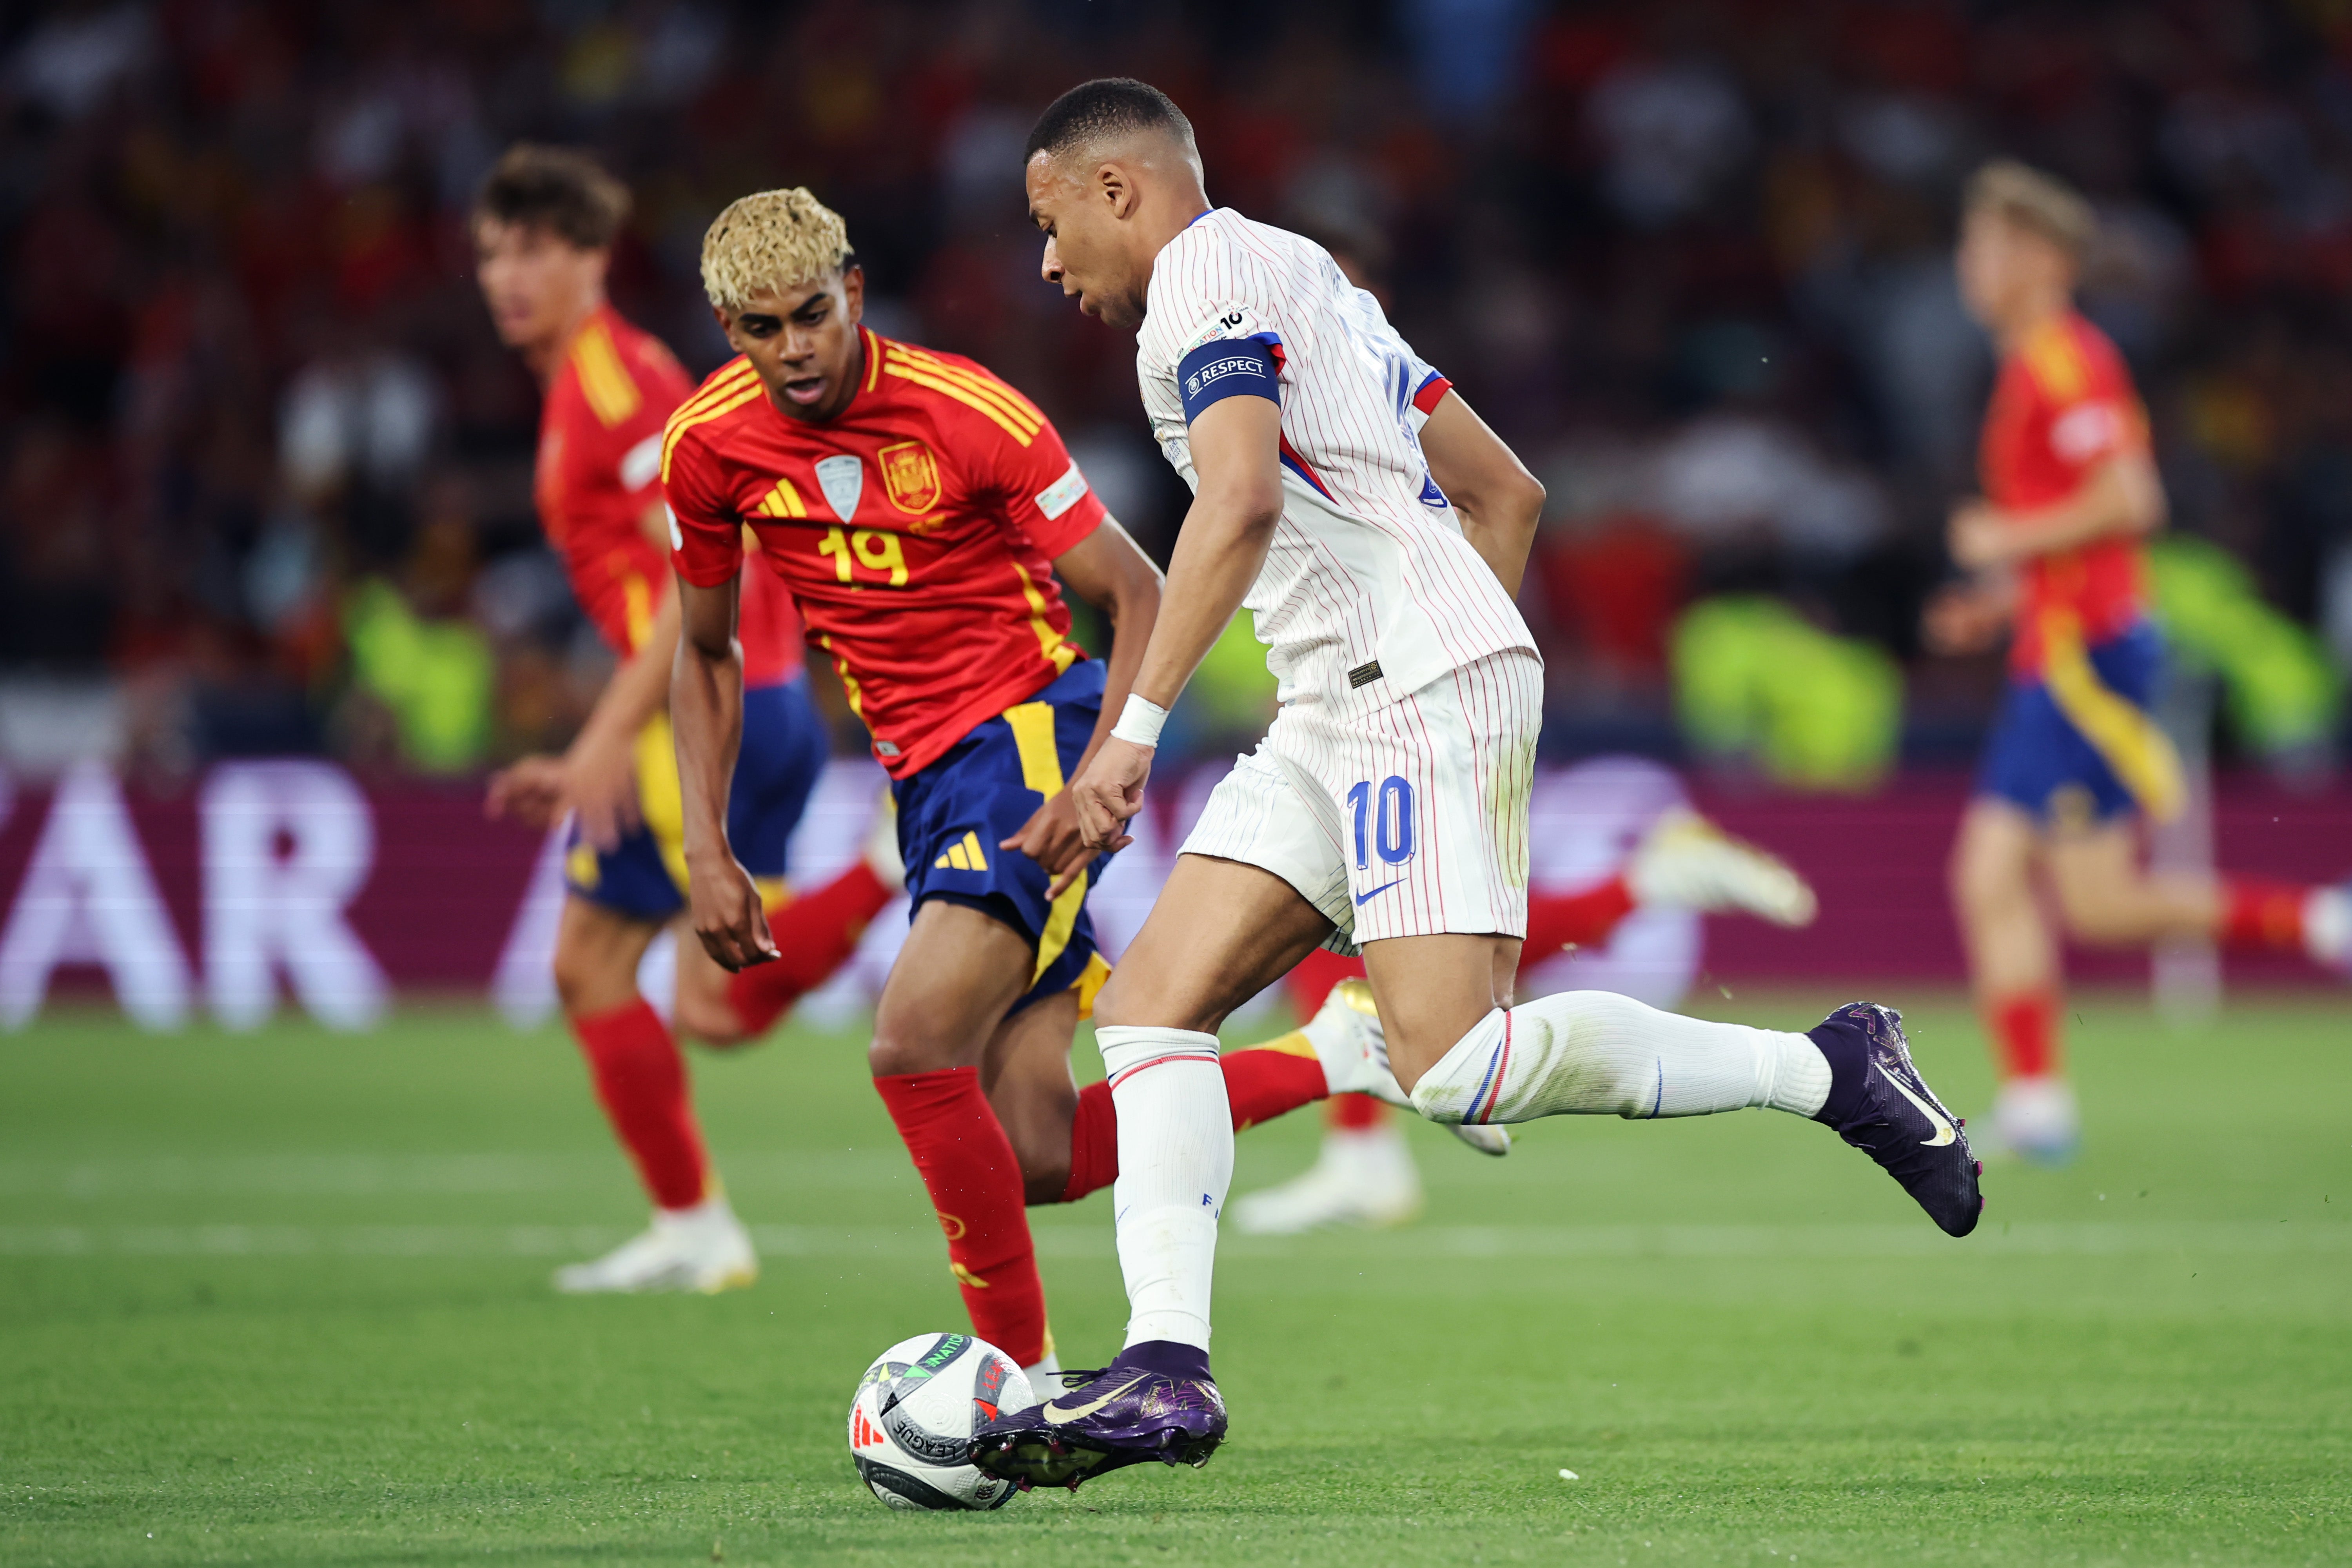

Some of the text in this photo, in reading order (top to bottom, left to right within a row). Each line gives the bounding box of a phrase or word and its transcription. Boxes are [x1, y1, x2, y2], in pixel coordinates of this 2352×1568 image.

[1220, 312, 1242, 330] 10
[1202, 360, 1263, 382] RESPECT
[818, 525, 909, 586] 19
[1347, 775, 1416, 870] 10
[0, 759, 392, 1033] AR
[893, 1421, 956, 1459] LEAGUE
